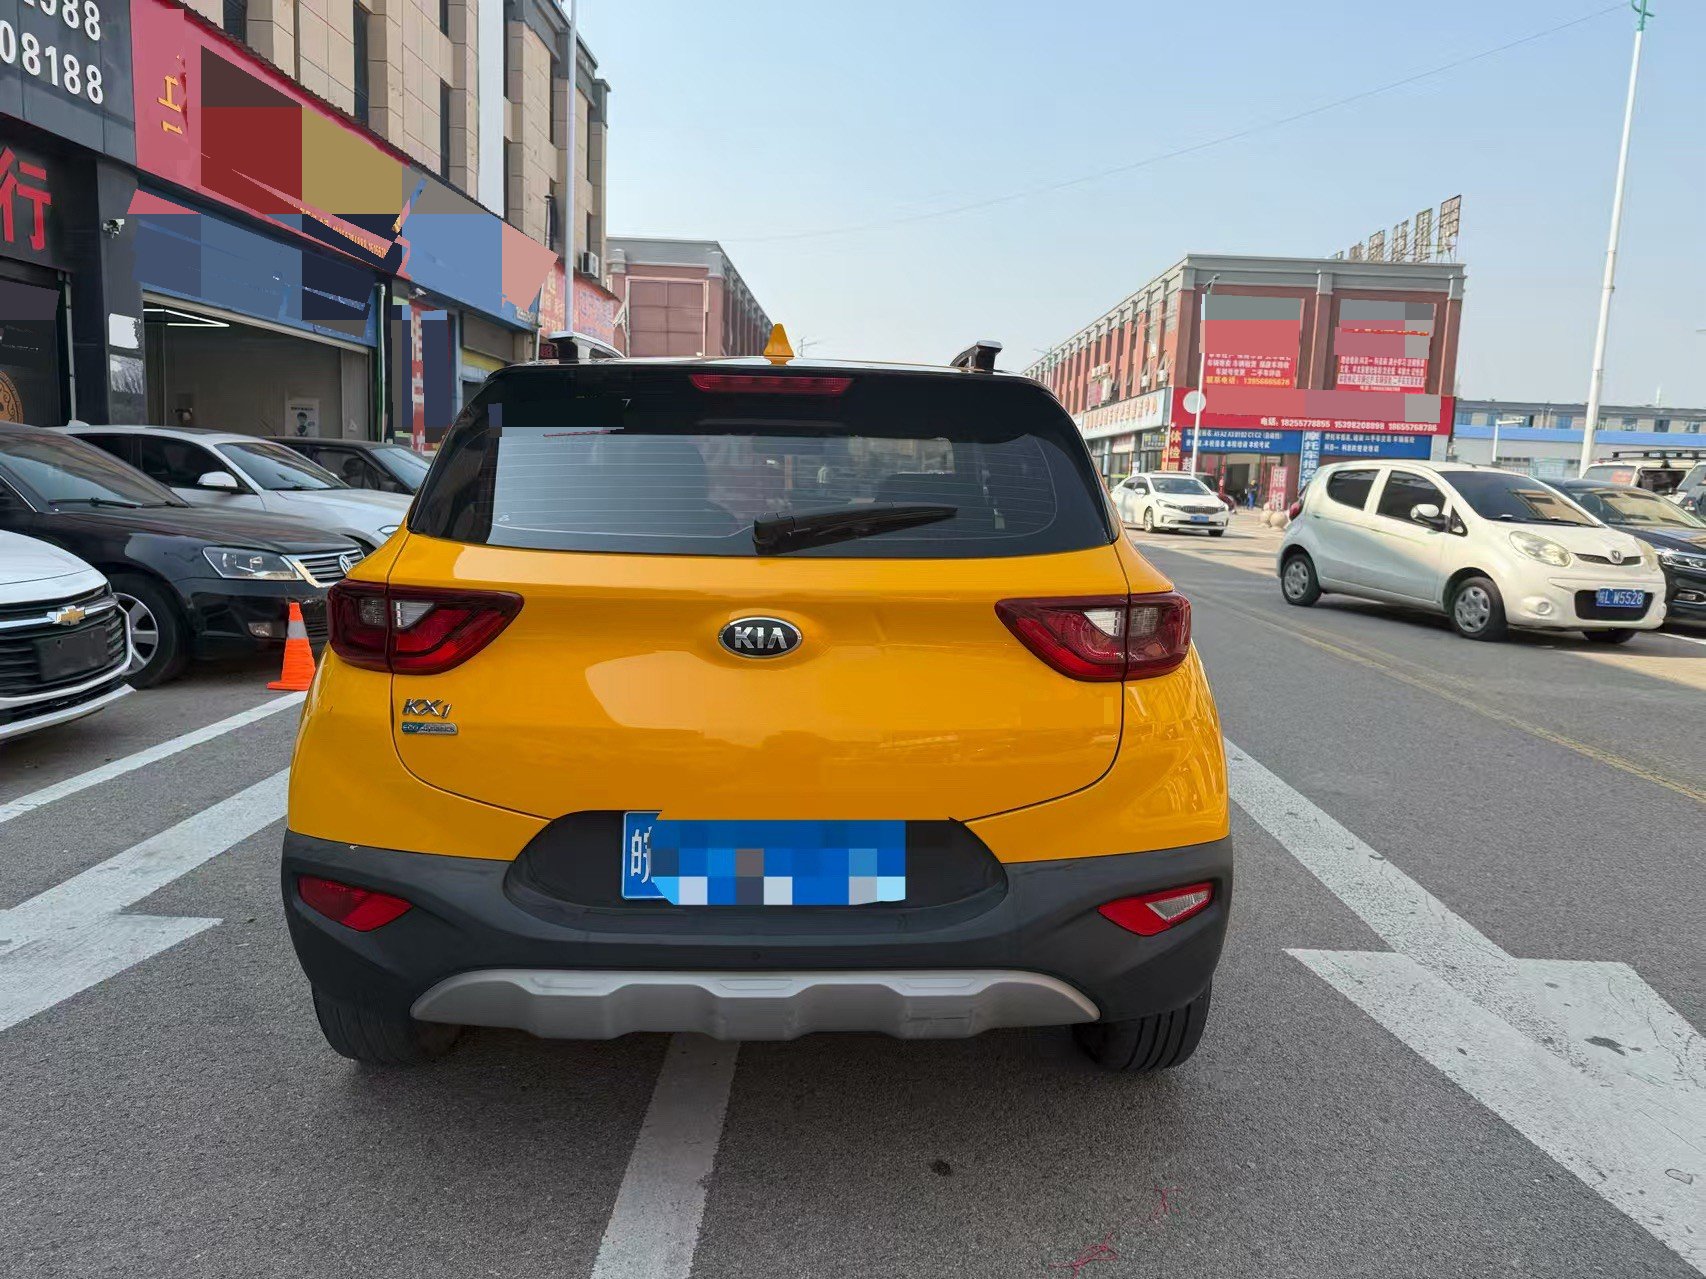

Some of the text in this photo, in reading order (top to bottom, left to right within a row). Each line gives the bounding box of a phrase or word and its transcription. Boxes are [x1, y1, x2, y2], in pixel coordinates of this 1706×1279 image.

[0, 20, 104, 105] 08188
[0, 146, 52, 250] 行
[734, 626, 788, 649] KIA
[402, 698, 452, 719] KX1
